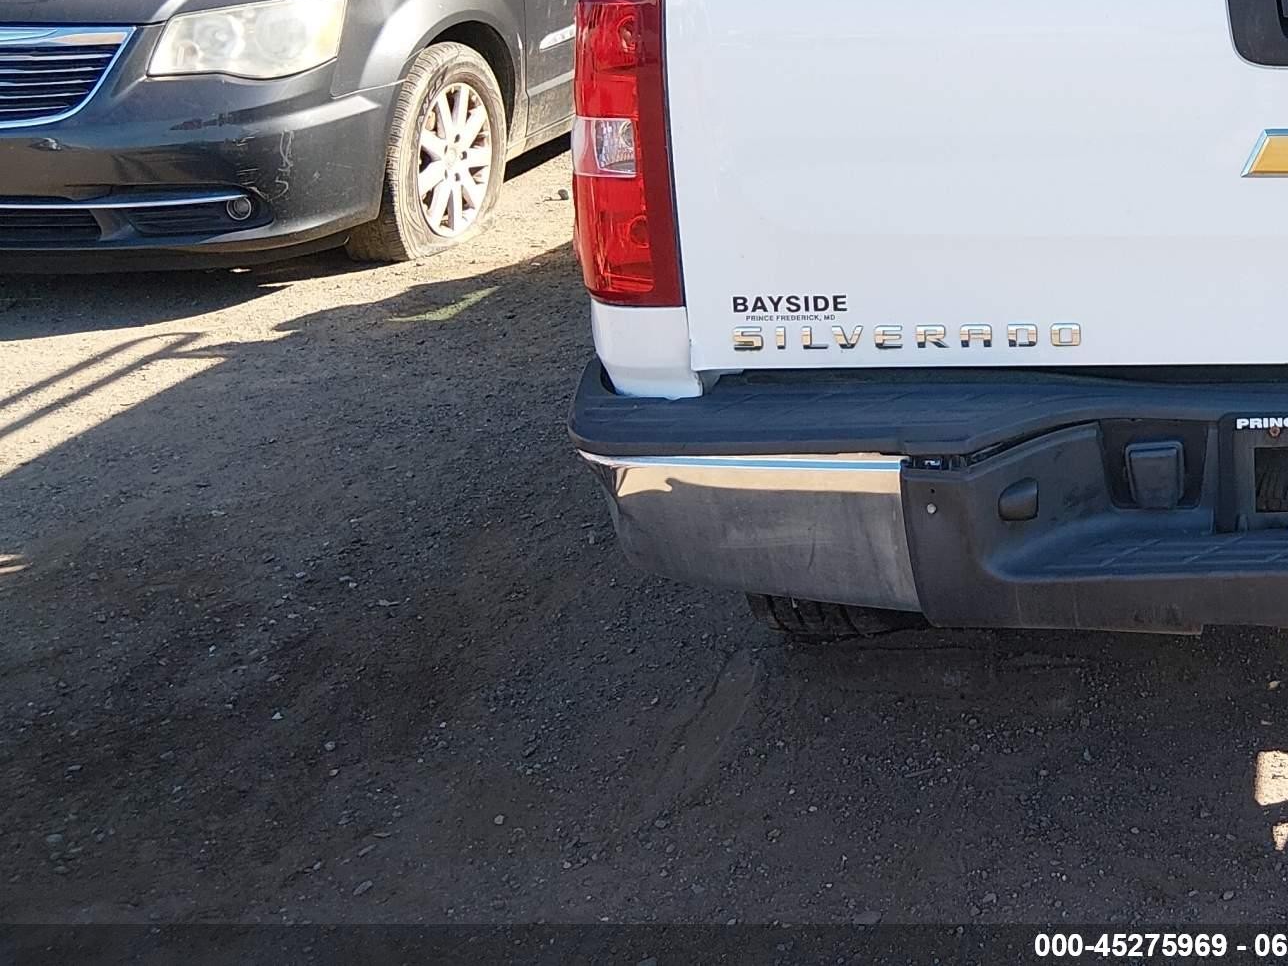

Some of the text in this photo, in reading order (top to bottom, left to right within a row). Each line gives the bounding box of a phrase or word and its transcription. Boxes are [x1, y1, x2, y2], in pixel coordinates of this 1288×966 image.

[732, 294, 848, 313] BAYSIDE
[776, 314, 822, 322] FREDERICK,
[732, 322, 1084, 352] SILVERADO
